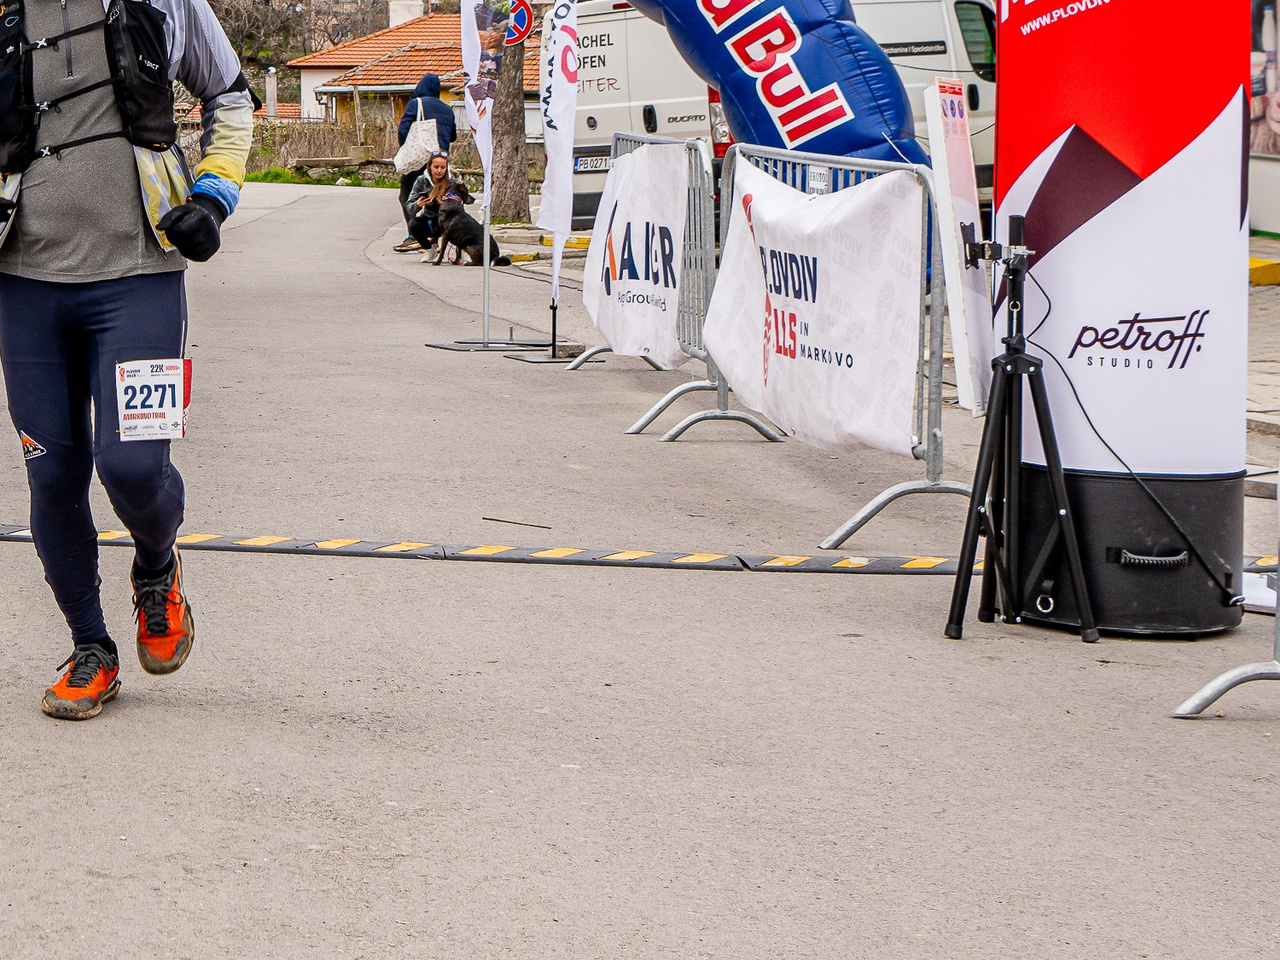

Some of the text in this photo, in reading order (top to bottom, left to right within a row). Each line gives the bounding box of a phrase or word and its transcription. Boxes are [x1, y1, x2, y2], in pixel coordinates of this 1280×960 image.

[728, 9, 851, 146] Bull
[668, 115, 706, 124] DUCATO
[150, 364, 164, 373] 22K
[1087, 357, 1153, 369] STUDIO
[123, 384, 176, 410] 2271
